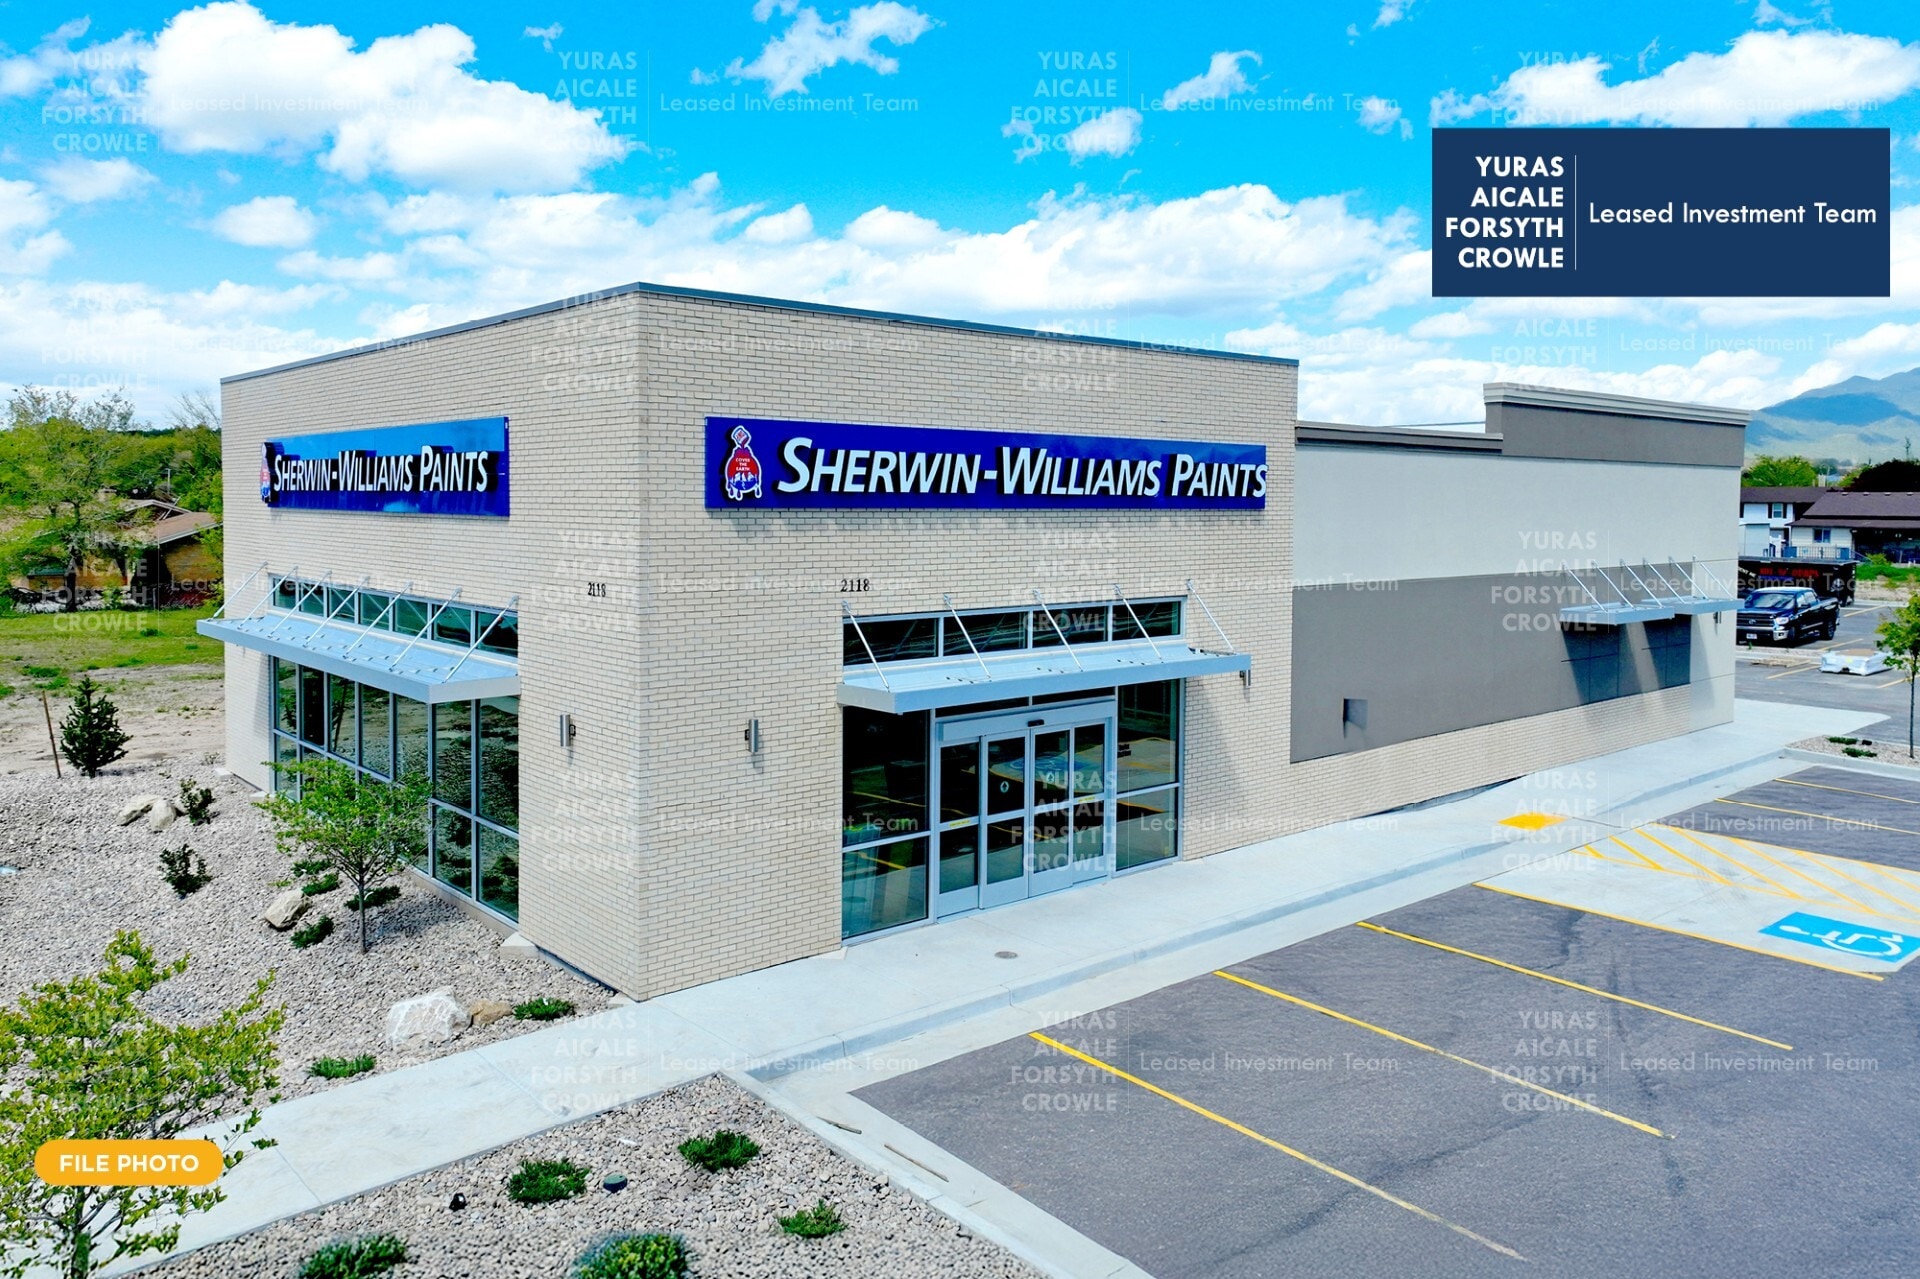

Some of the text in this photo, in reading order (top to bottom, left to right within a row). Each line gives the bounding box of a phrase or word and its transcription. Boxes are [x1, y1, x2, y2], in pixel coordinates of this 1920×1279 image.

[273, 445, 489, 492] SHERWIN-WILLIAMS PAINTS
[777, 437, 1268, 498] SHERWIN-WILLIAMS PAINTS
[587, 582, 606, 598] 2118
[840, 578, 870, 592] 2118
